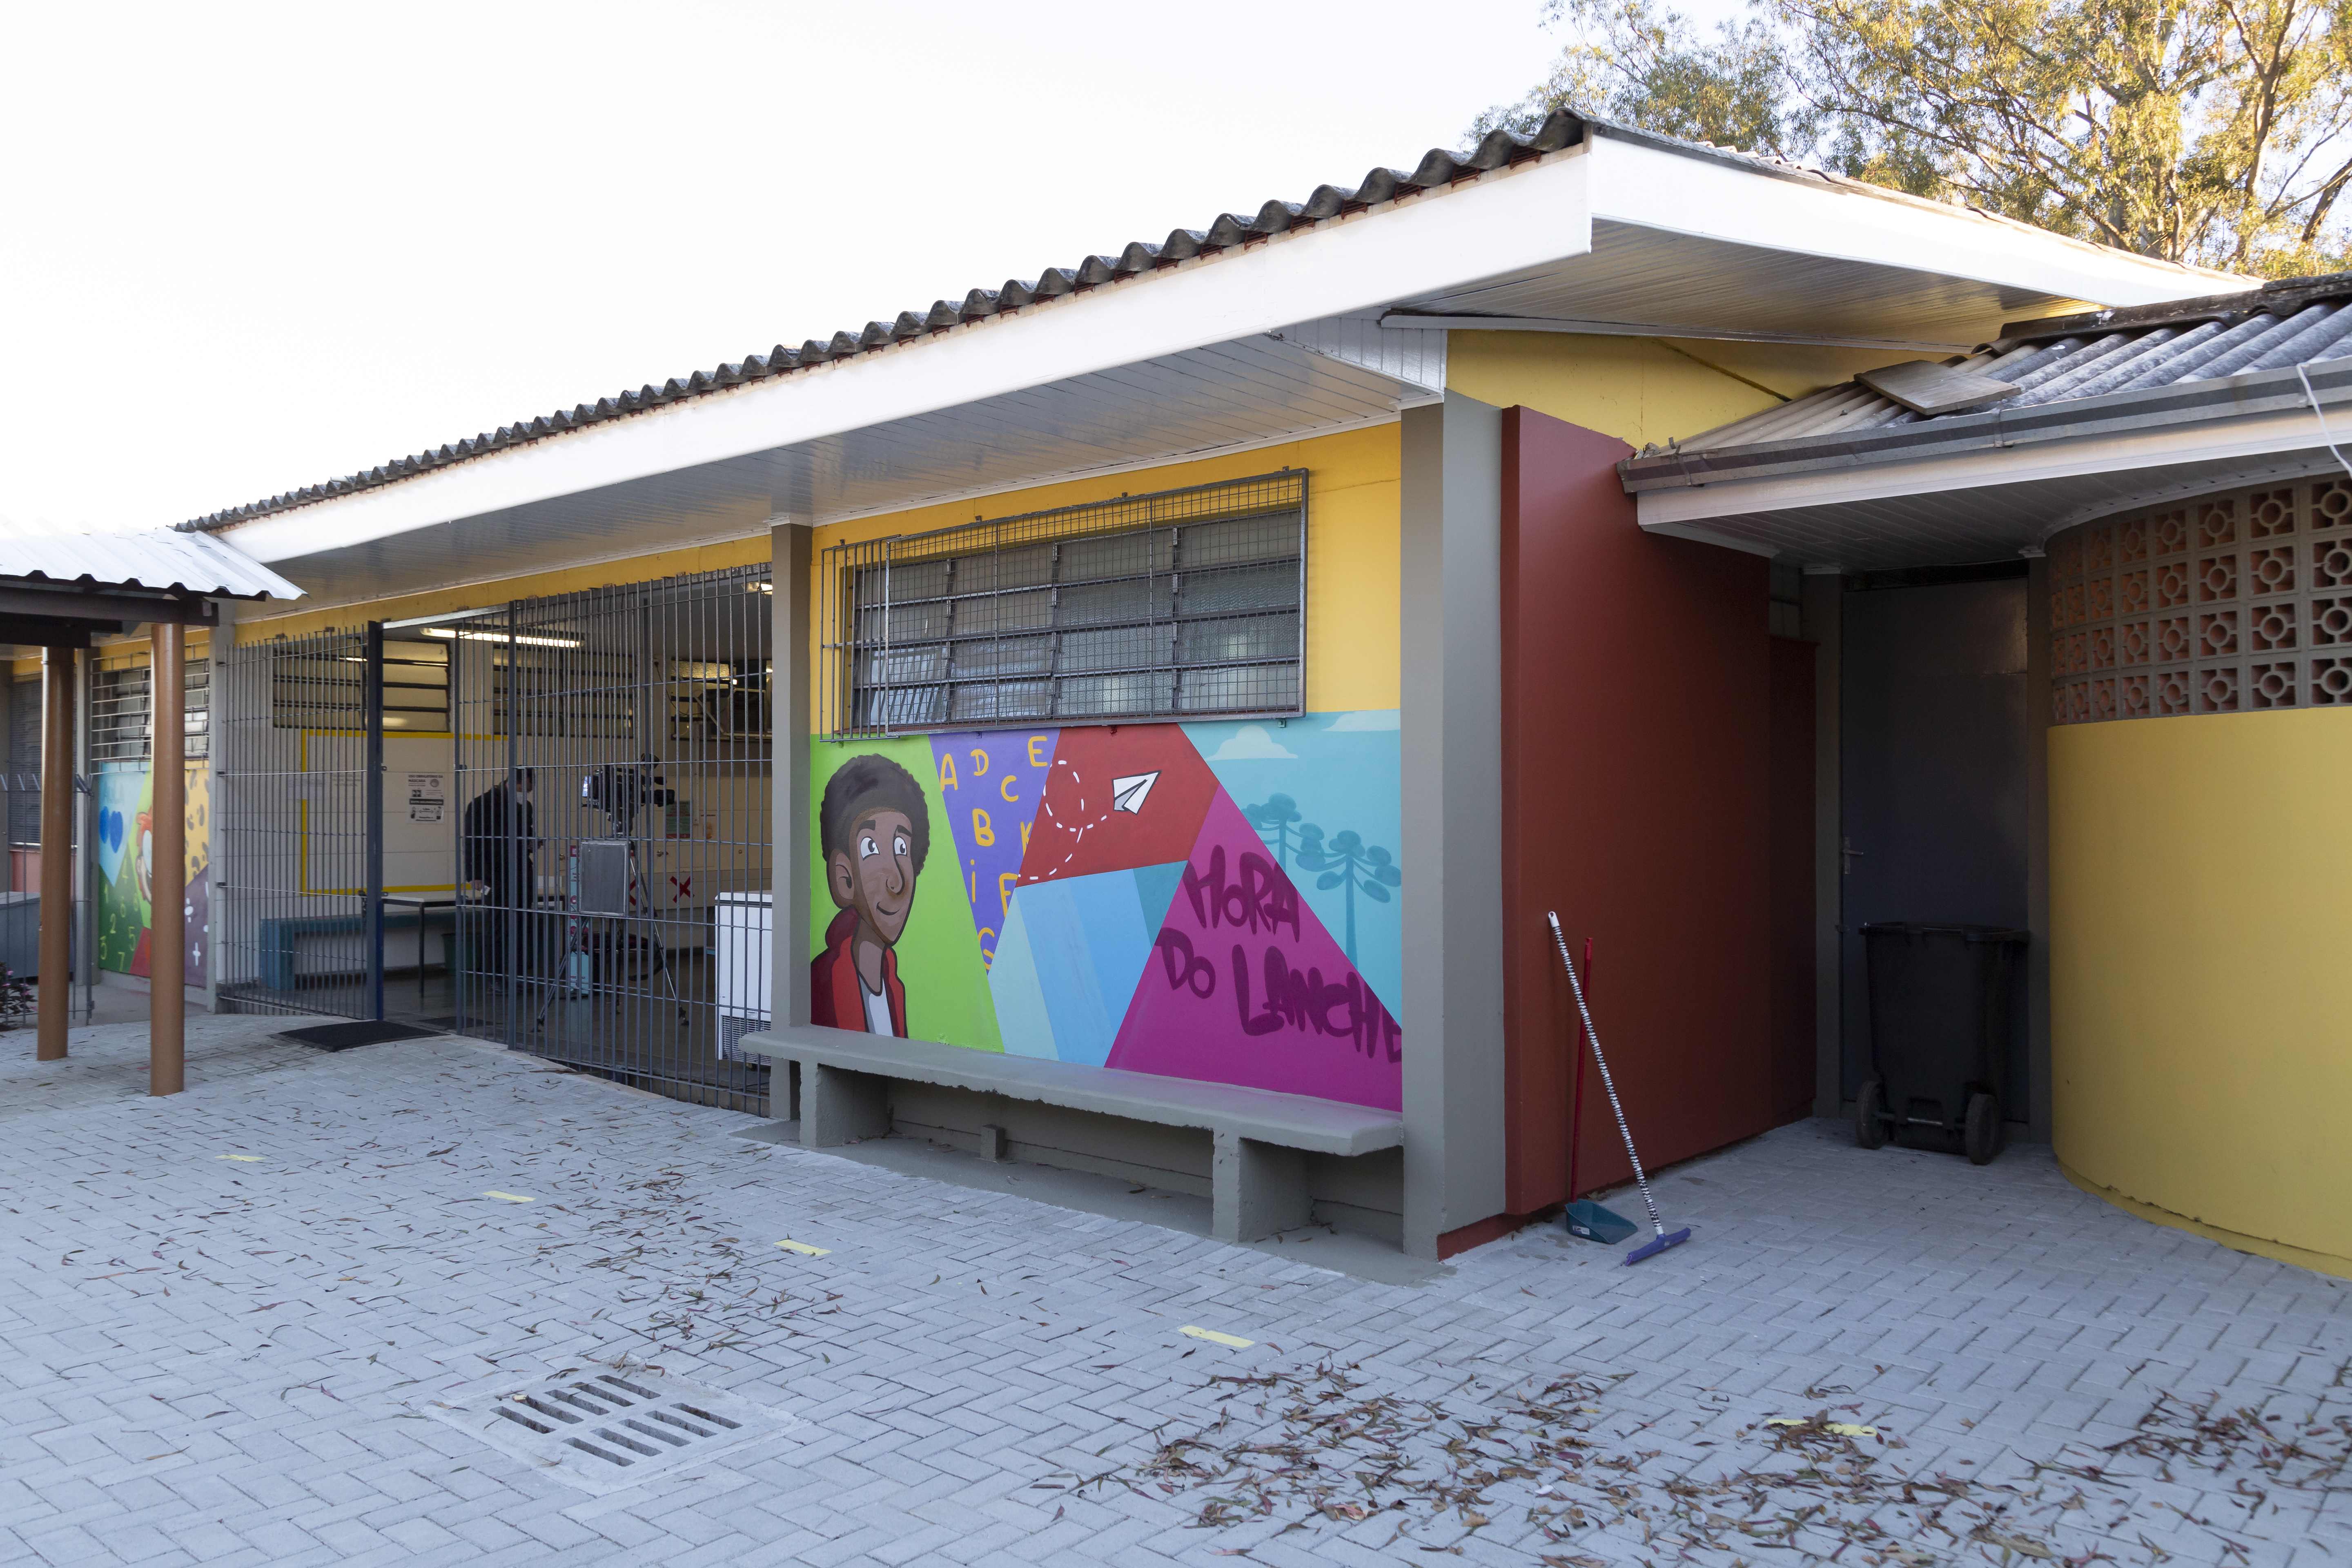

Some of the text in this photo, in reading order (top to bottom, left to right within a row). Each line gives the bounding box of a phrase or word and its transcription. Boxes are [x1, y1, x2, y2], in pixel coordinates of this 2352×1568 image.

[970, 748, 989, 776] D
[1028, 736, 1048, 767] E
[940, 753, 958, 792] A
[1000, 775, 1019, 802] C
[972, 808, 995, 847] B
